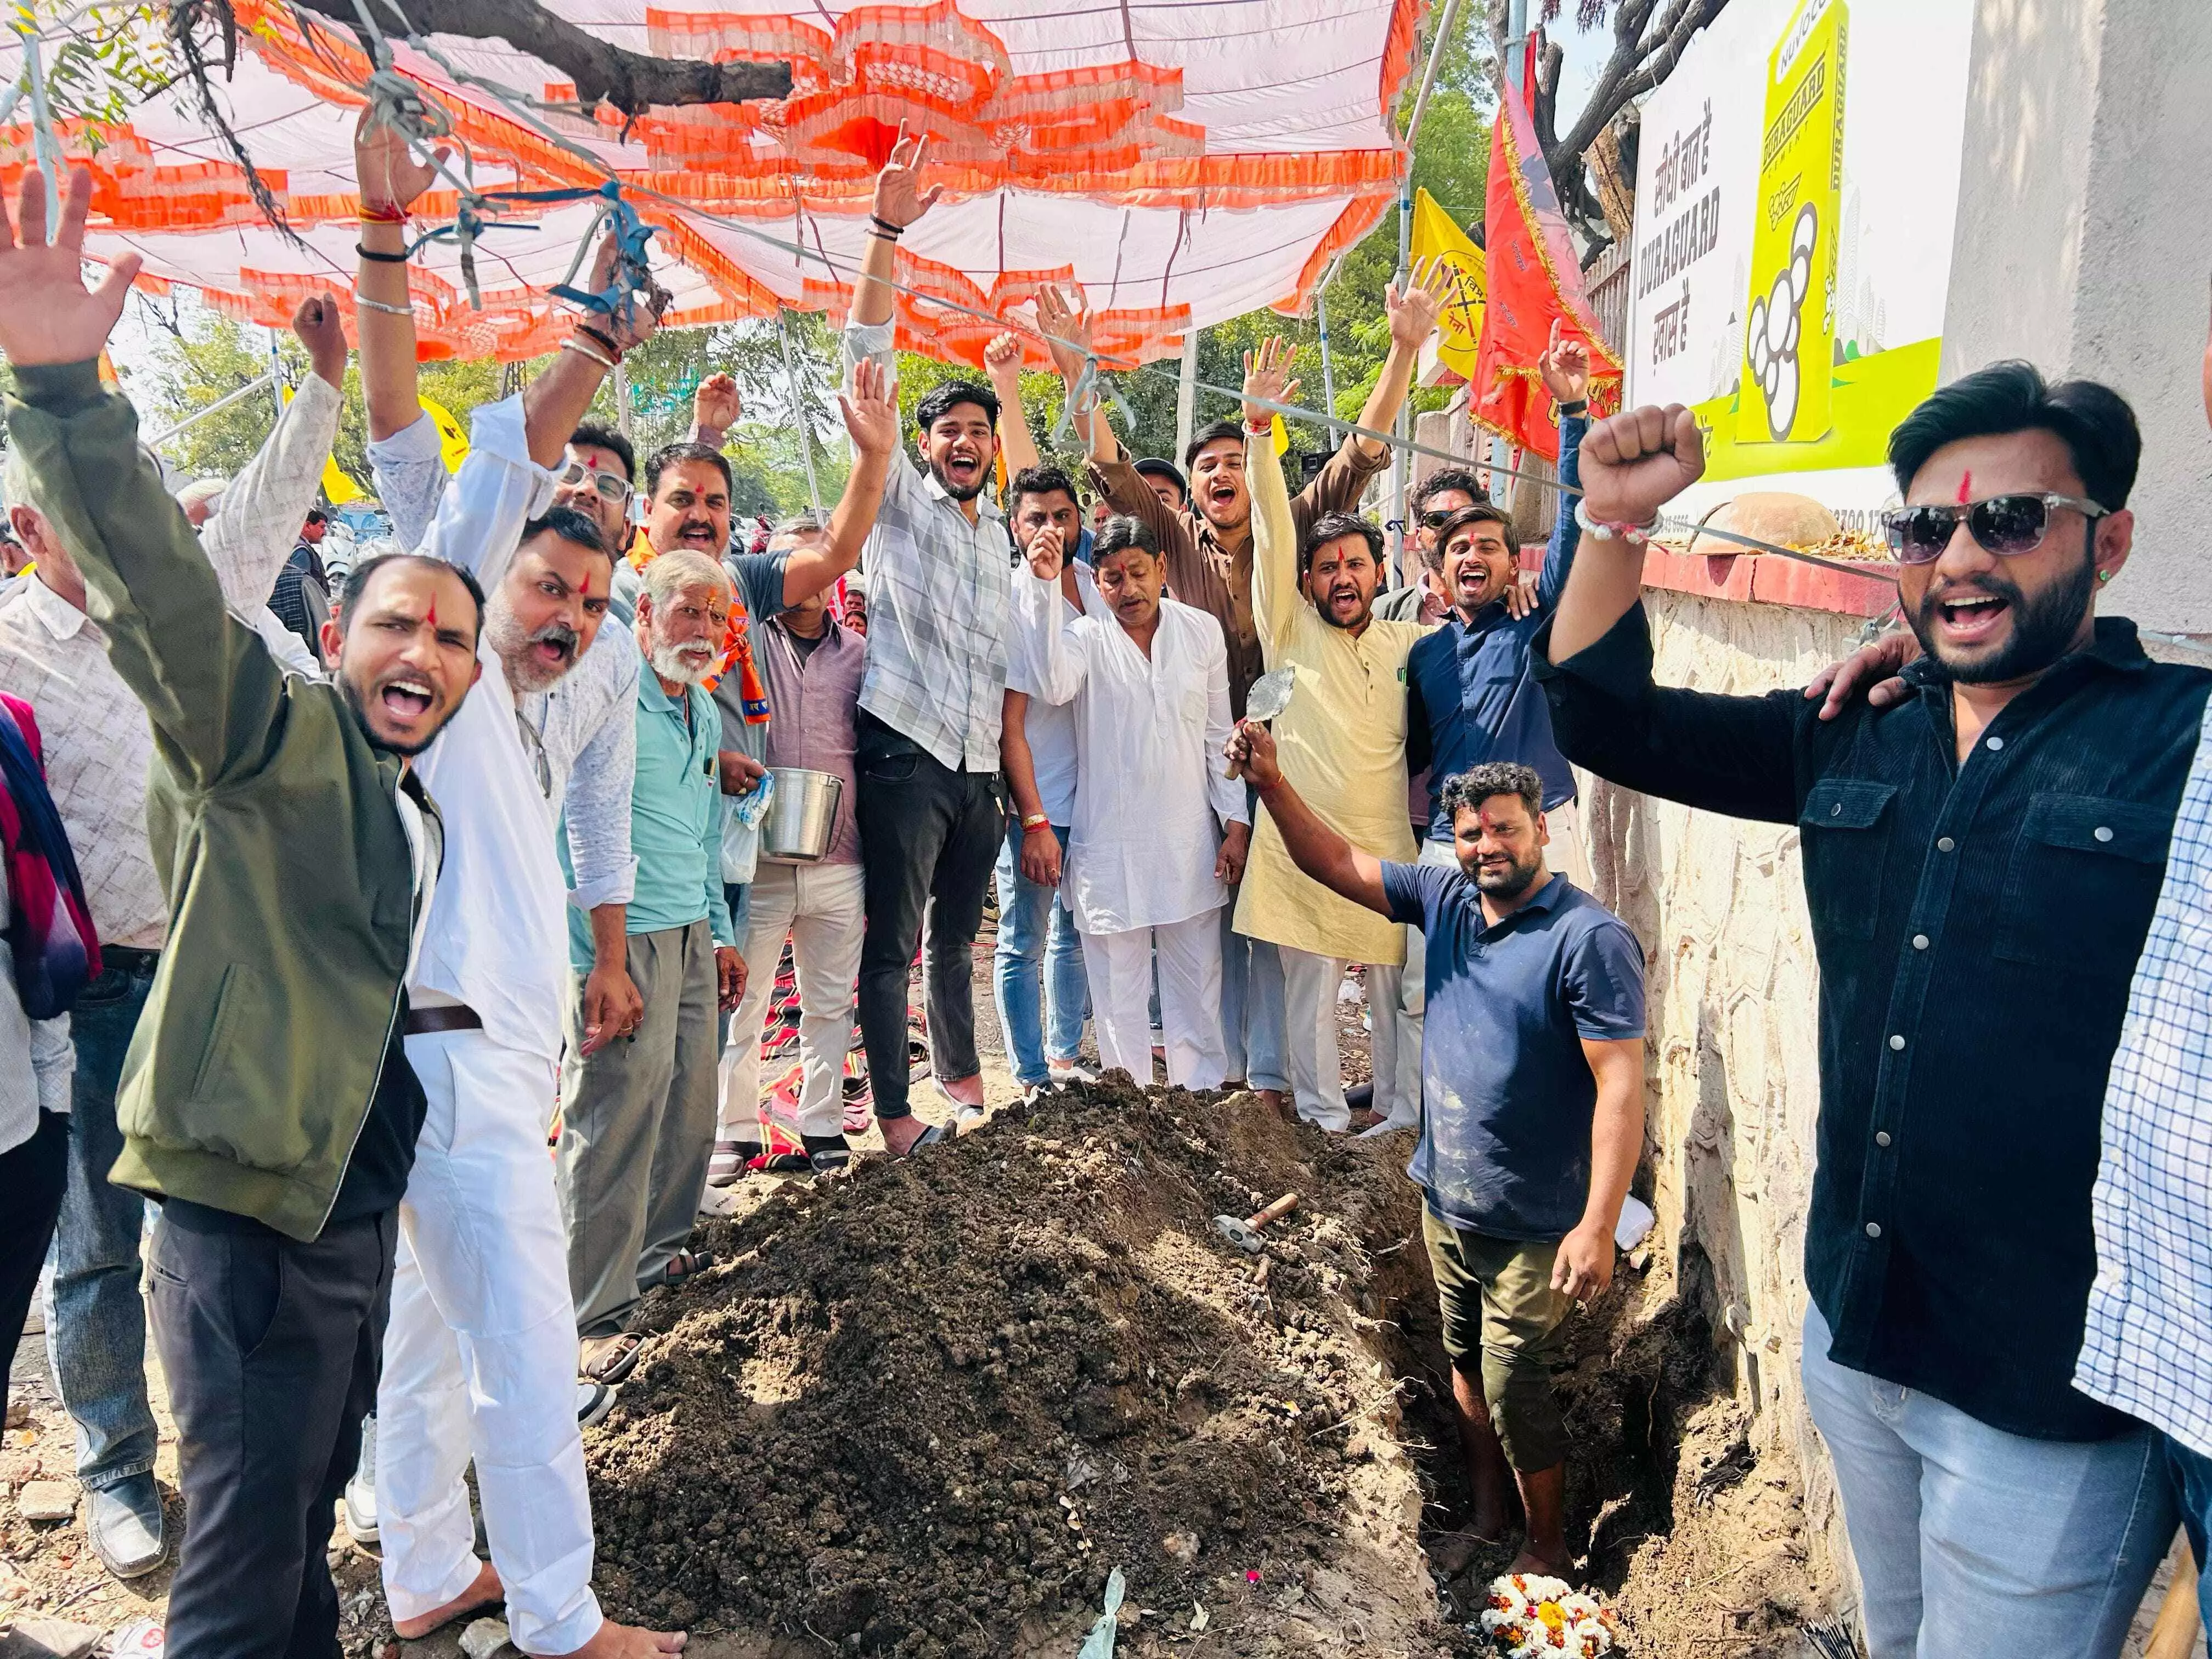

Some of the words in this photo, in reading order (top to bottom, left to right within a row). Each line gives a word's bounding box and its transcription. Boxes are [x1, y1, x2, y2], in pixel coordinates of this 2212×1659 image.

[1655, 128, 1680, 218] सीधी
[1680, 123, 1702, 193] बात
[1701, 96, 1712, 176] है
[1763, 61, 1825, 167] DURAGUARD
[1832, 25, 1846, 191] DURAGUARD
[1638, 185, 1720, 300] DURAGUARD
[1680, 276, 1690, 352] है
